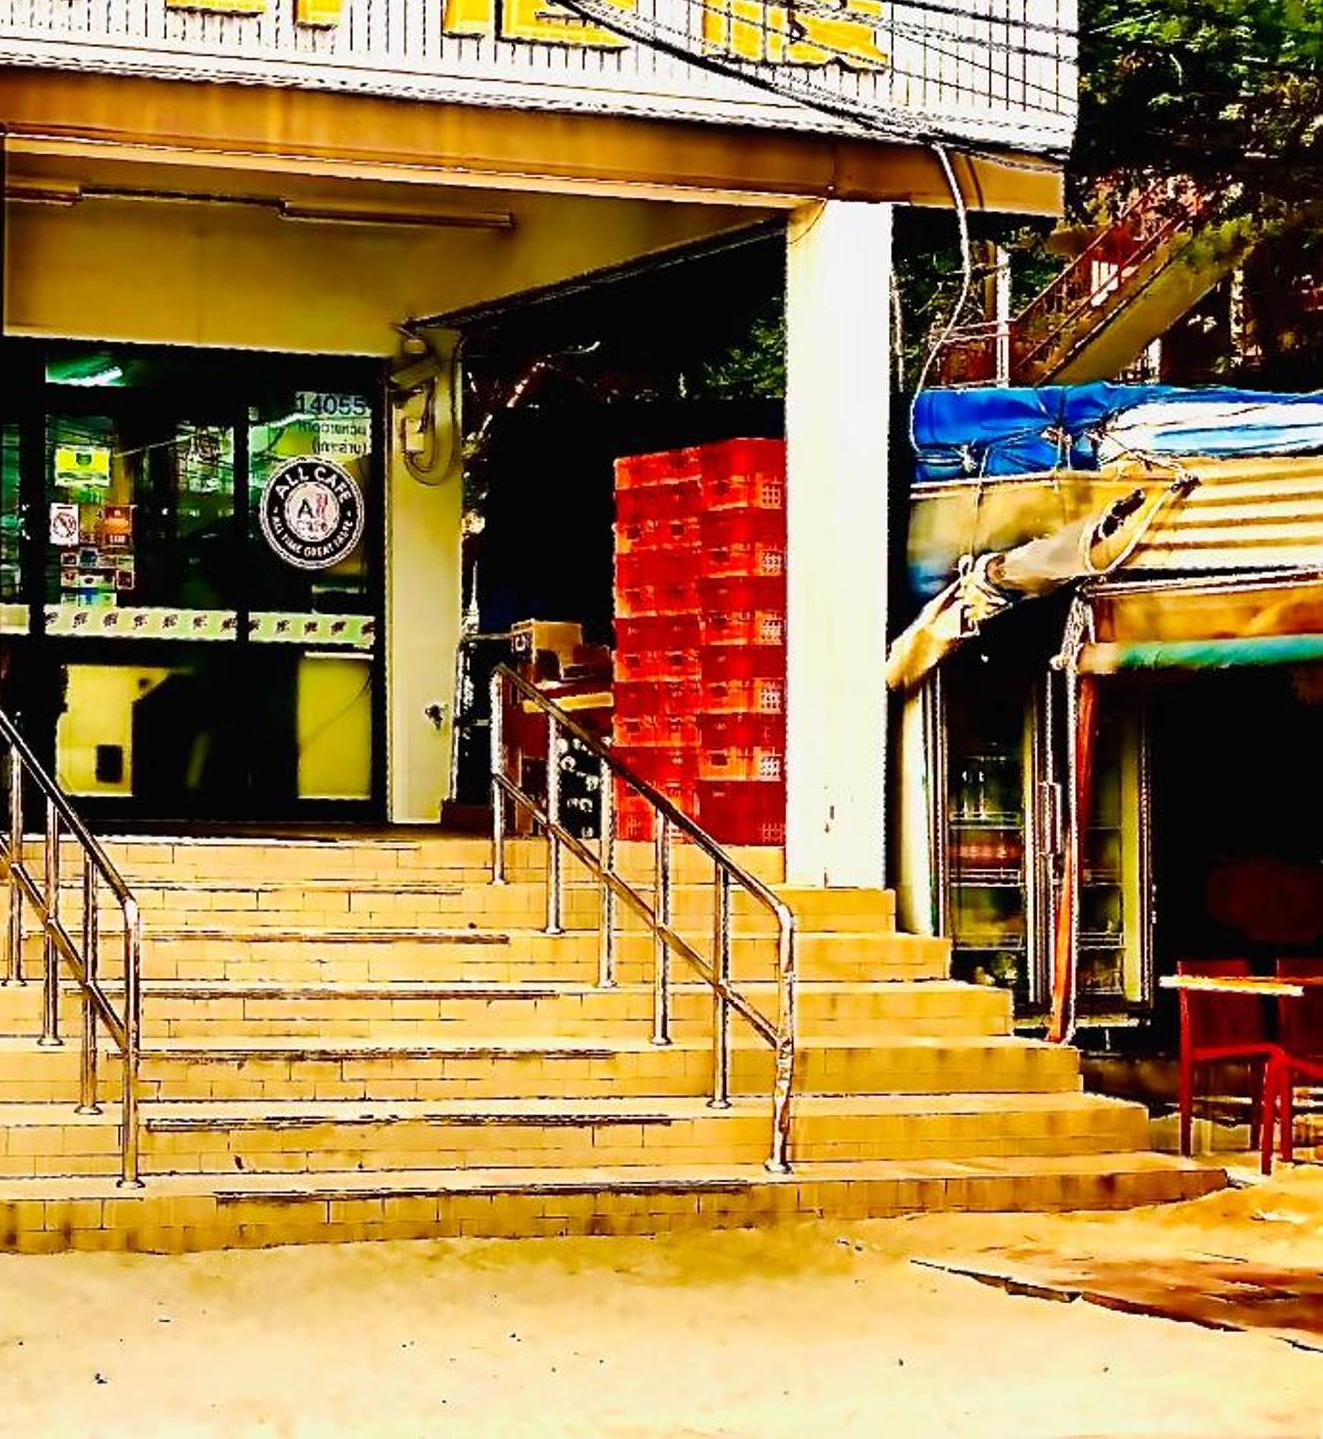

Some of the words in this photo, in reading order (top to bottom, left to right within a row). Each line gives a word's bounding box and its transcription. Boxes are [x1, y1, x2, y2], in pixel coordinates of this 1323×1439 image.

[296, 393, 366, 416] 14055
[276, 466, 309, 499] ALL
[304, 542, 335, 558] GREAT
